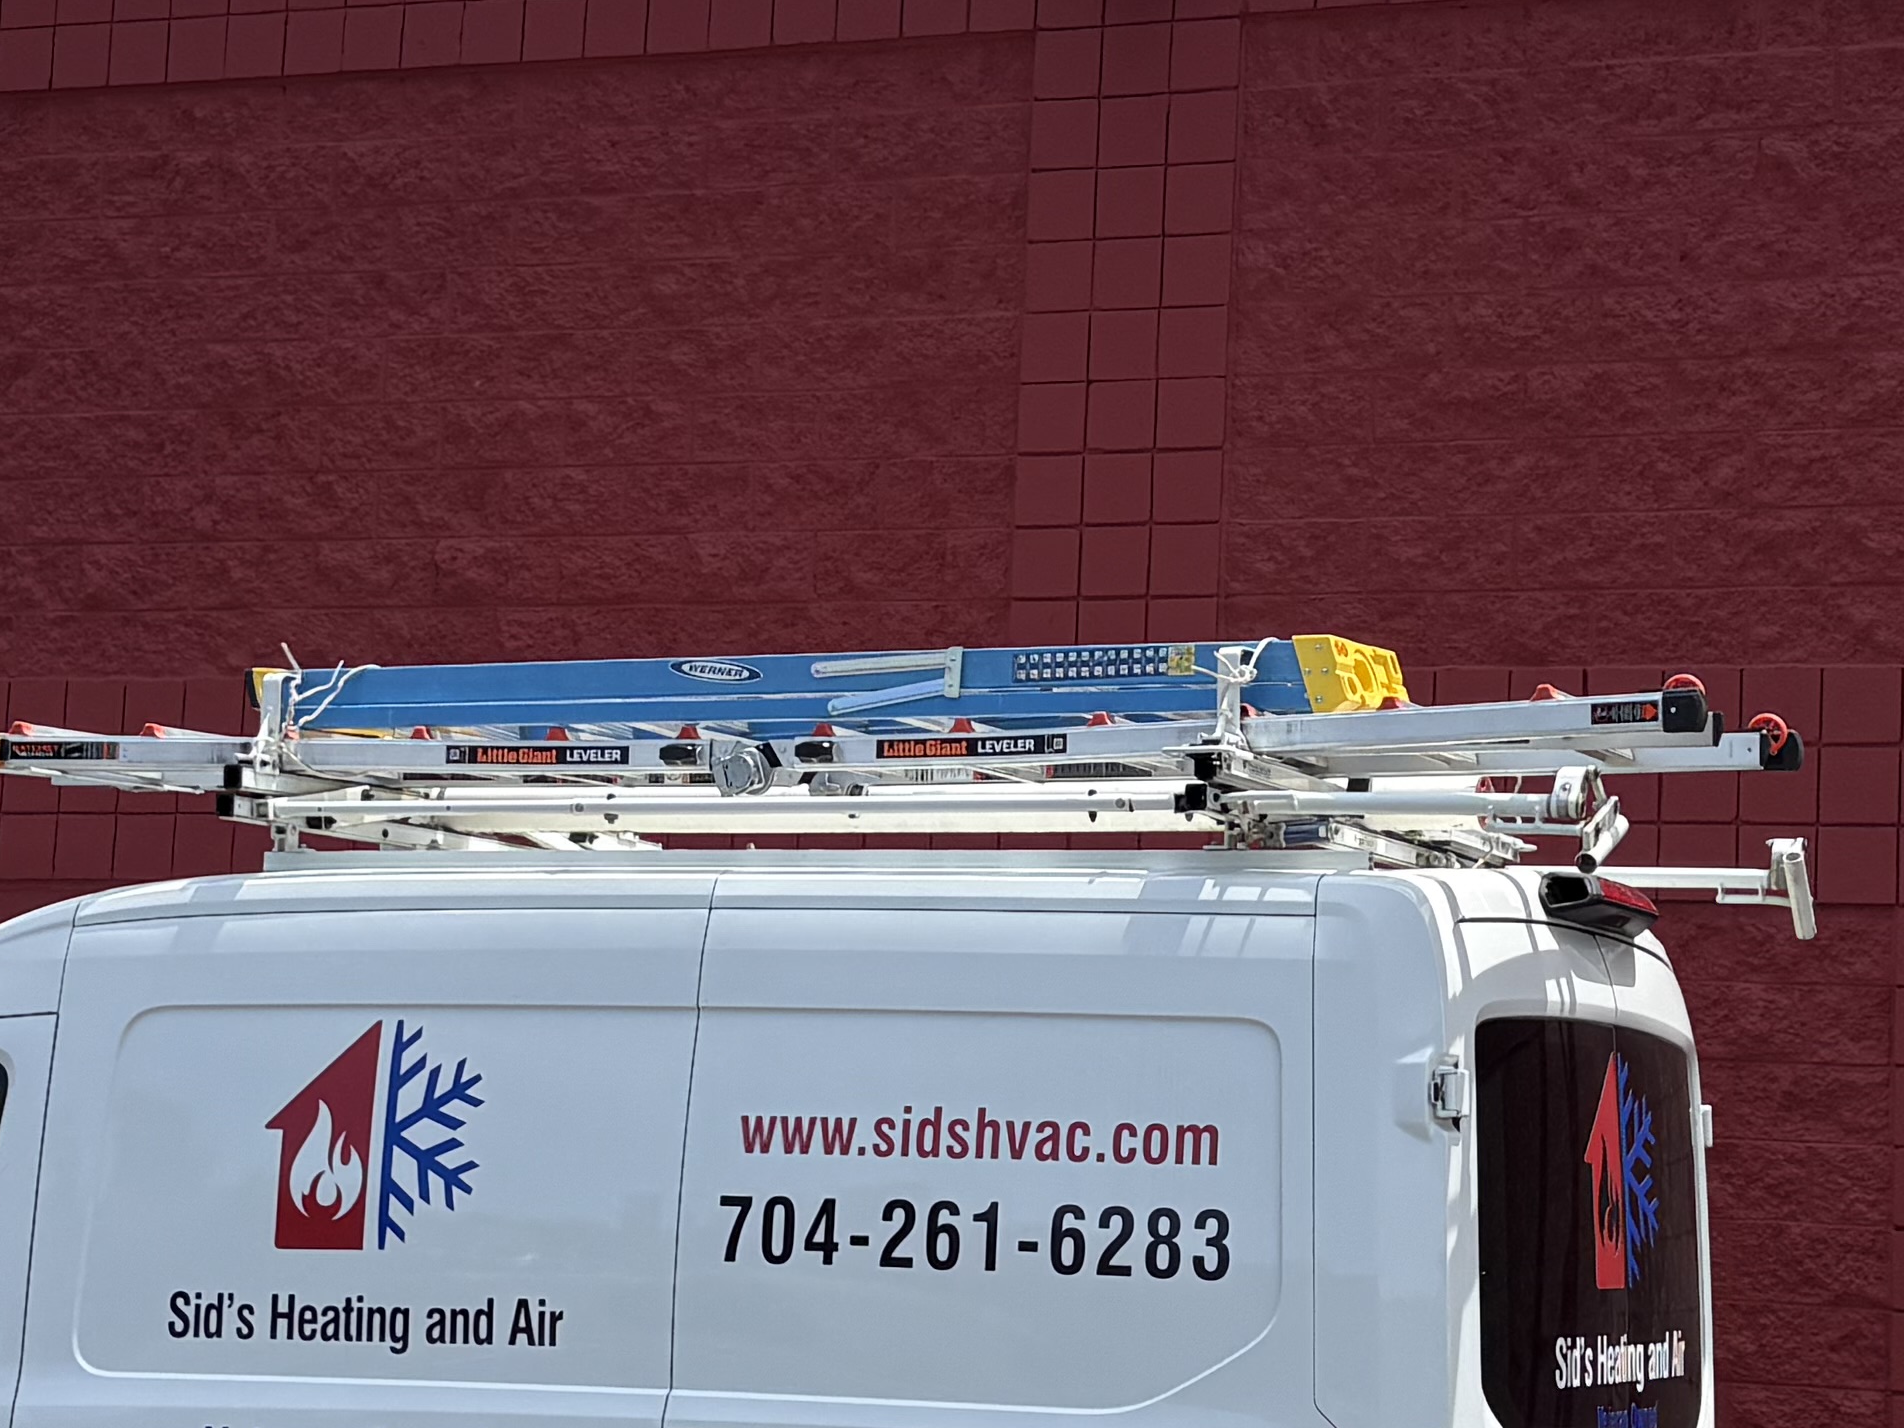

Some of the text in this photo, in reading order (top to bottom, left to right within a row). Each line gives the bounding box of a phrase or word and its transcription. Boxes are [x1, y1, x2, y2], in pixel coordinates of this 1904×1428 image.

[688, 664, 745, 678] WERNER
[566, 749, 622, 762] LEVELER
[977, 739, 1035, 754] LEVELER
[741, 1106, 1219, 1166] www.sidshvac.com
[719, 1195, 1231, 1282] 704-261-6283
[167, 1290, 564, 1355] Sid's Heating and Air
[1555, 1330, 1686, 1392] Sid's Heating and Air
